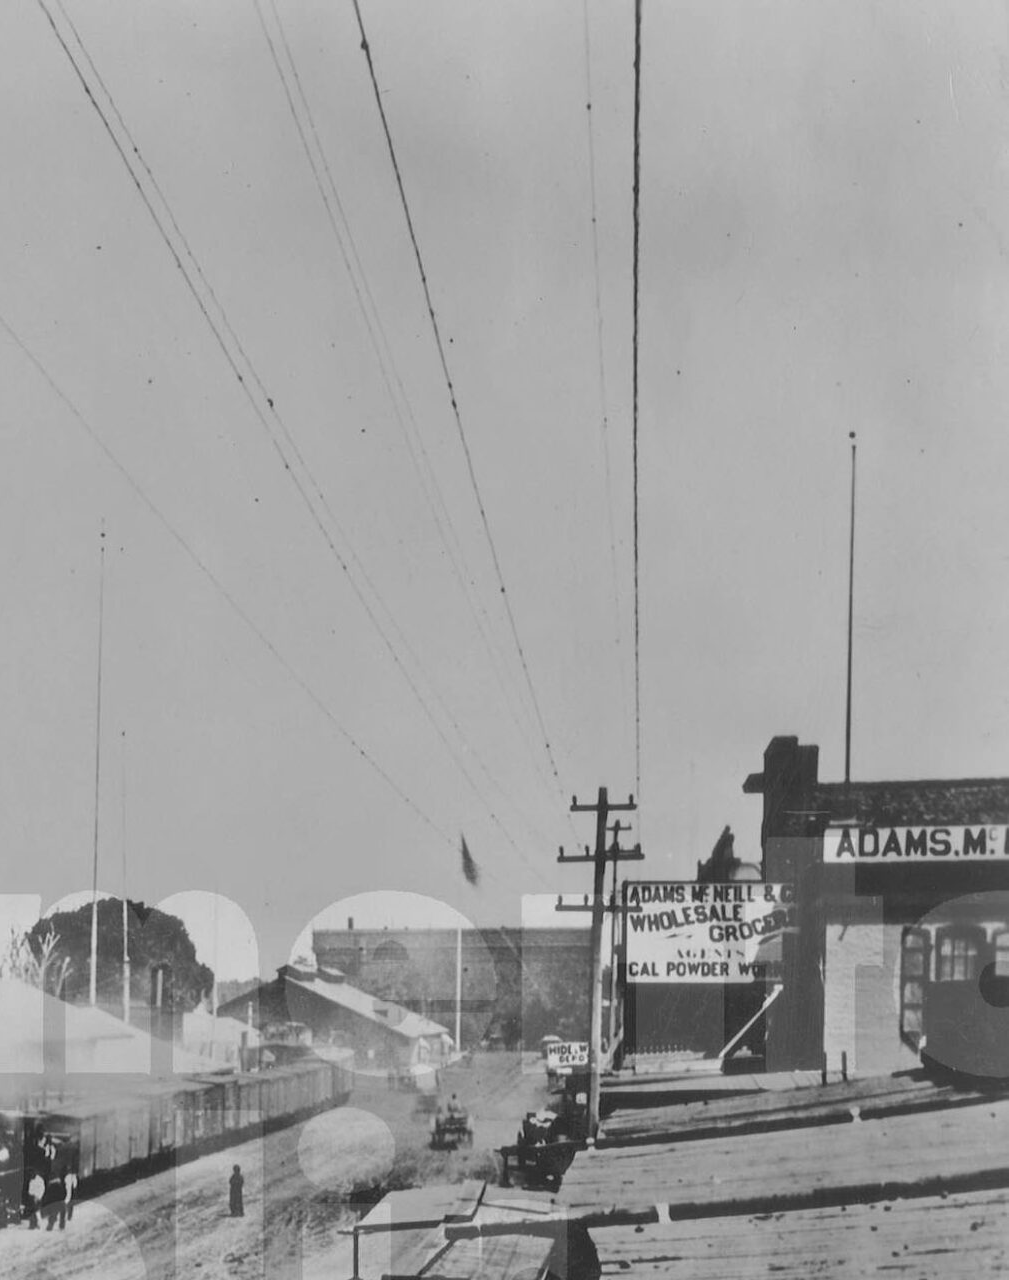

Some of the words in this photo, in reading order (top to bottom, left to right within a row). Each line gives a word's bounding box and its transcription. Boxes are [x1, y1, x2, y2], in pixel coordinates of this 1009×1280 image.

[629, 885, 685, 904] ADAMS
[764, 884, 777, 902] &
[629, 904, 743, 932] WHOLESALE
[628, 961, 659, 977] CAL
[666, 961, 729, 977] POWDER
